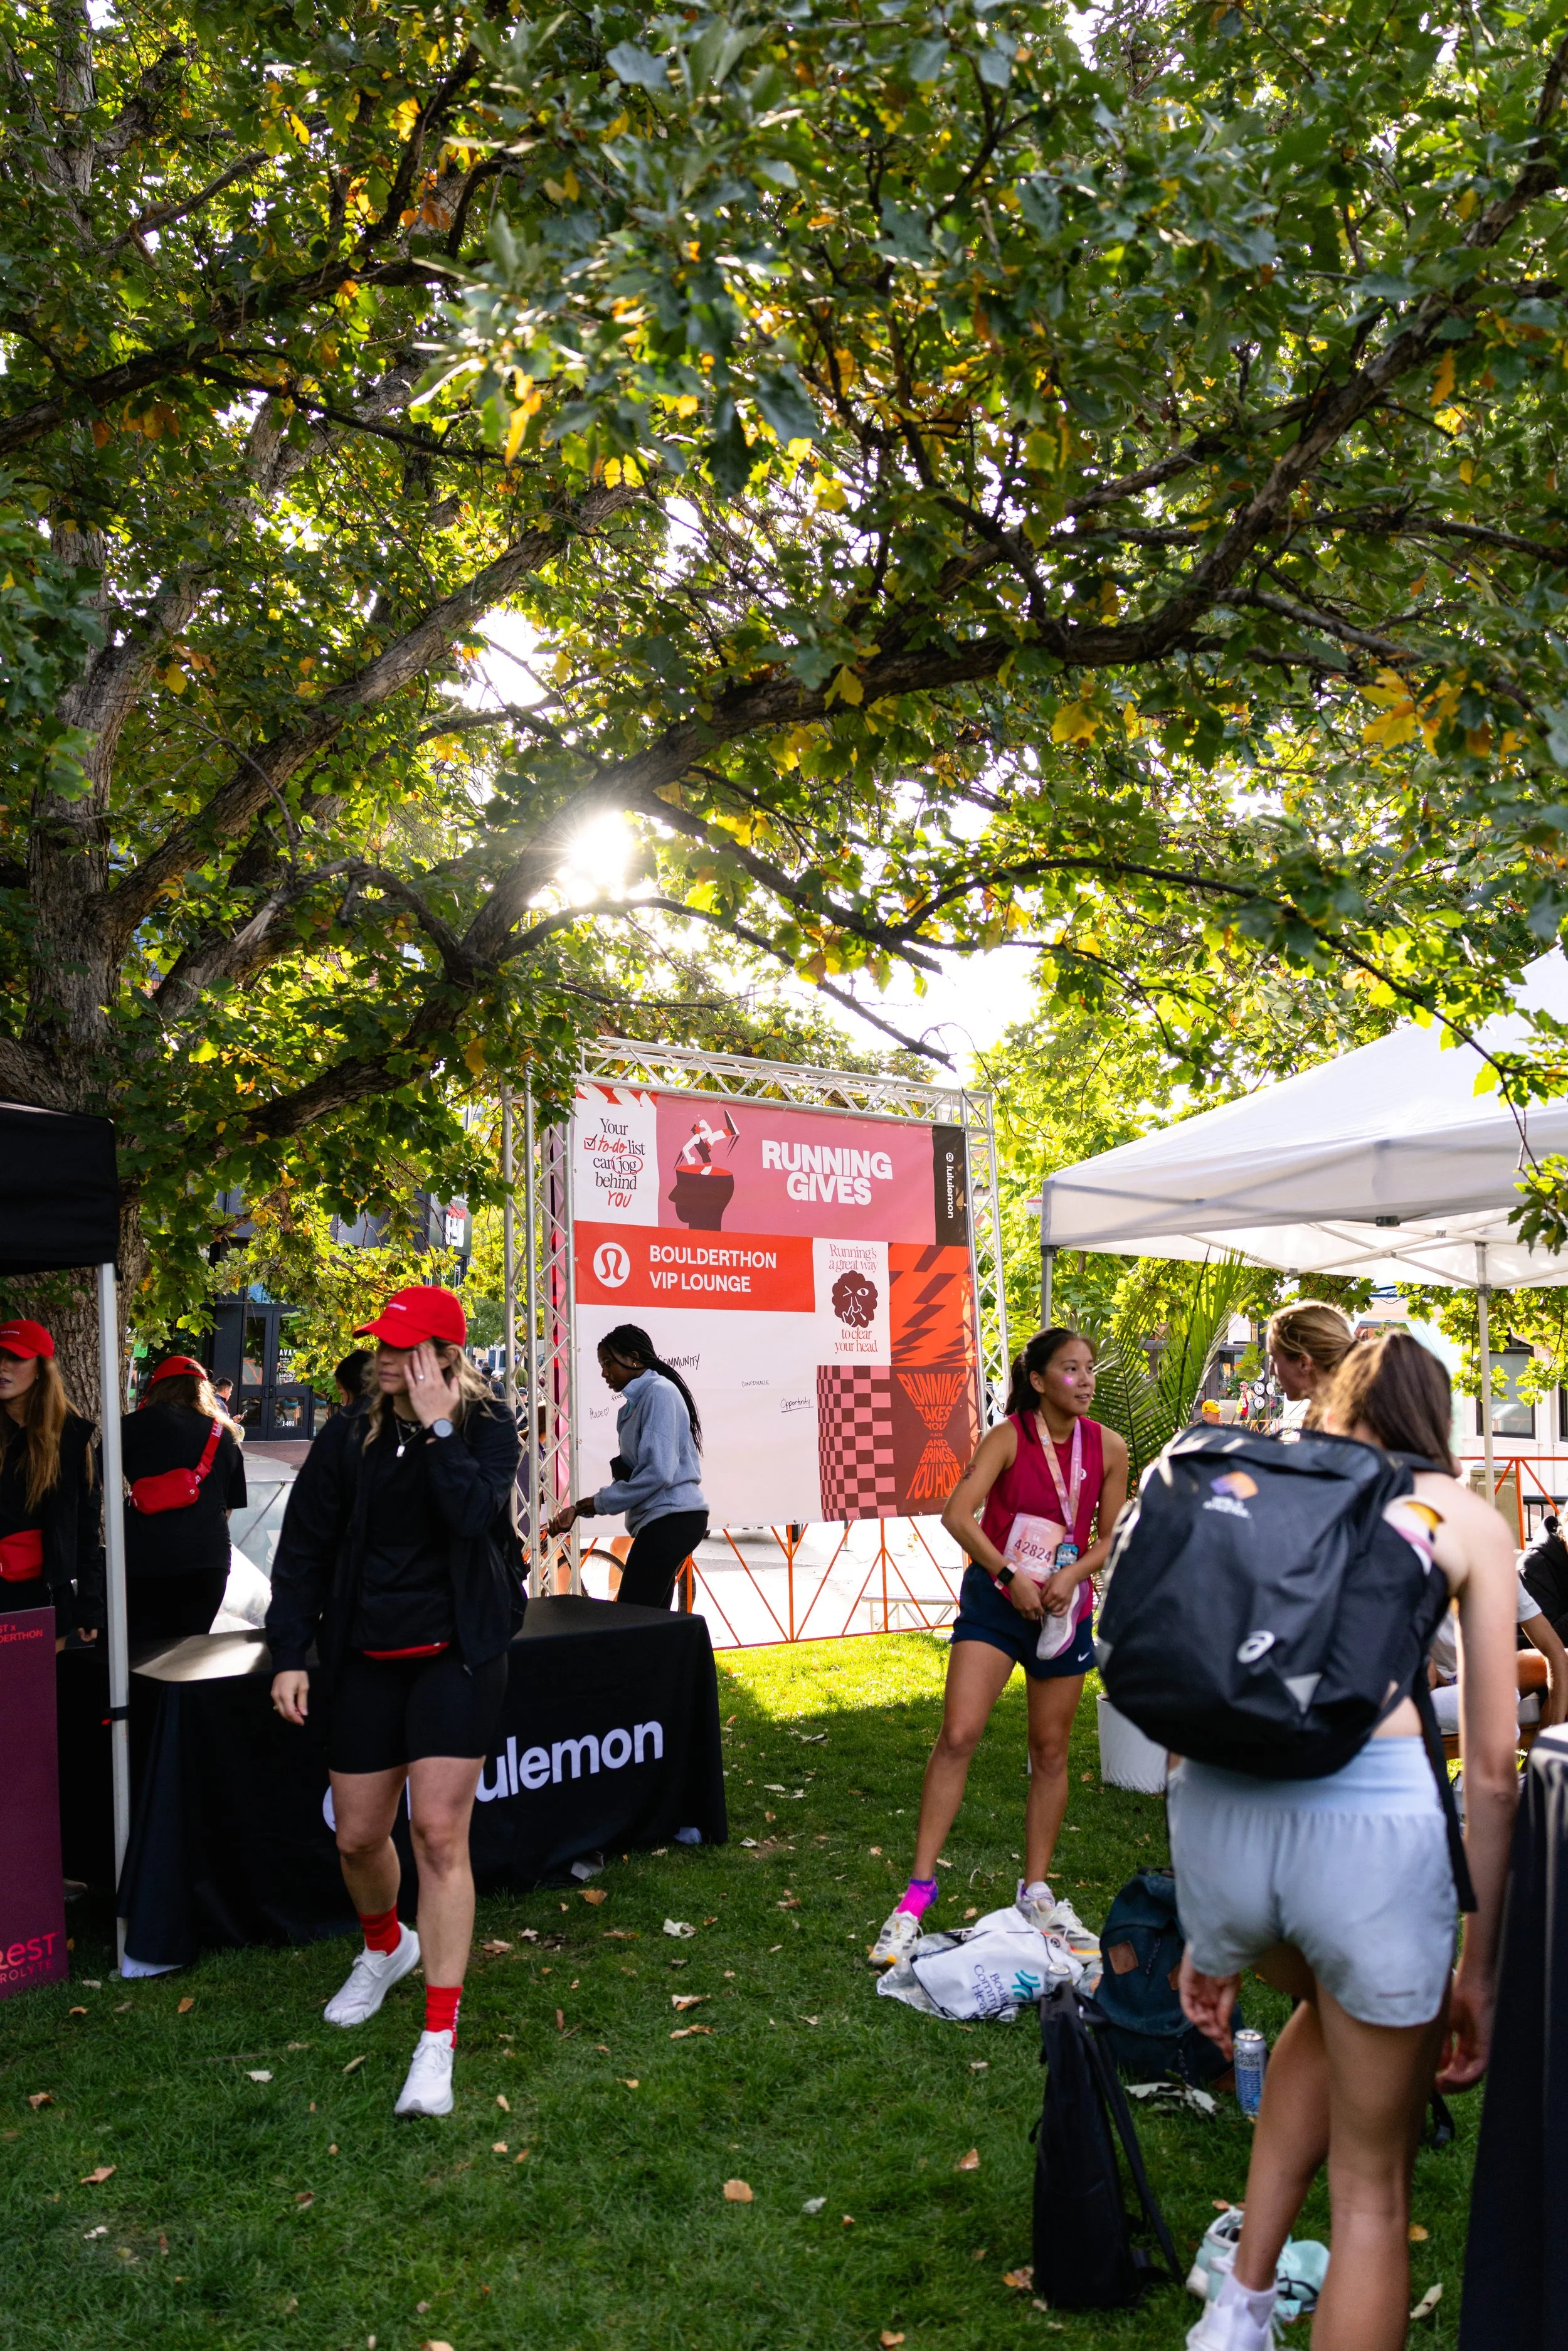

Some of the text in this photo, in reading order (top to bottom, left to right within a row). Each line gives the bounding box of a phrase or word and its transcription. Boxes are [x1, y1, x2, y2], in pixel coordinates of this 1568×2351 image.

[600, 1118, 628, 1135] Your
[597, 1134, 646, 1155] to-do list
[593, 1157, 637, 1176] can jog
[761, 1139, 894, 1181] RUNNING
[595, 1171, 638, 1190] behind
[787, 1171, 872, 1206] GIVES
[607, 1190, 632, 1208] YOU
[946, 1165, 955, 1219] lululemon
[650, 1244, 776, 1269] BOULDERTHON
[829, 1244, 877, 1261] Running's
[829, 1260, 878, 1273] a great way
[649, 1271, 751, 1292] VIP LOUNGE
[842, 1327, 872, 1339] to clear
[835, 1340, 878, 1354] your head
[896, 1373, 967, 1406] RUNNING
[780, 1396, 811, 1410] Opportunity
[589, 1408, 603, 1420] Peace
[914, 1406, 953, 1422] TAKES
[923, 1422, 948, 1431] YOU
[926, 1439, 948, 1447] AND
[919, 1446, 957, 1463] BRINGS
[906, 1464, 935, 1499] YOU
[1014, 1539, 1052, 1563] 42824
[406, 1721, 663, 1820] ulemon
